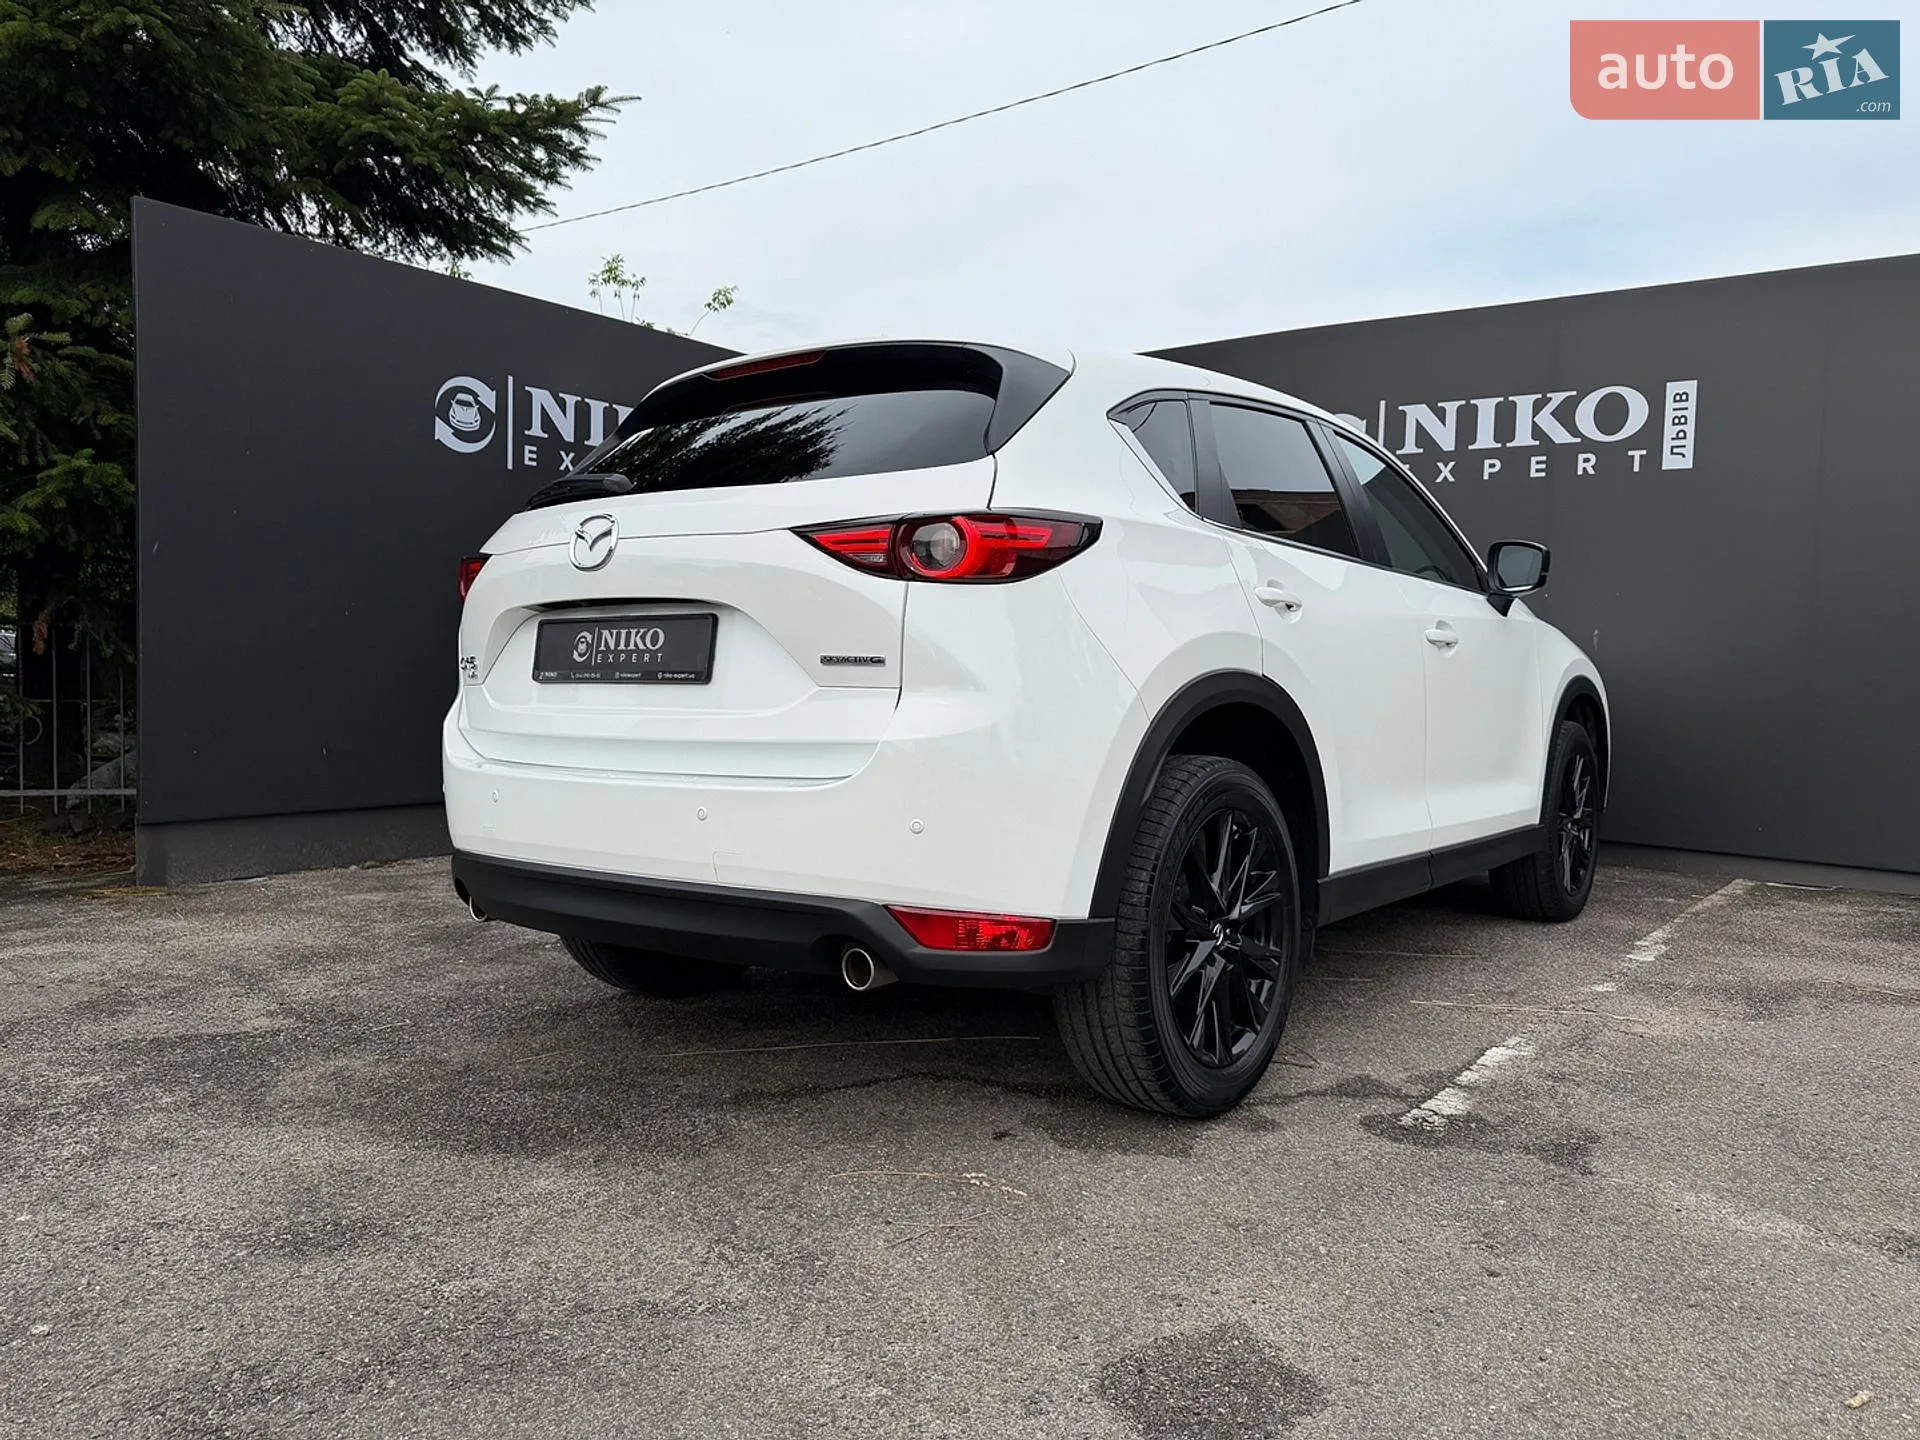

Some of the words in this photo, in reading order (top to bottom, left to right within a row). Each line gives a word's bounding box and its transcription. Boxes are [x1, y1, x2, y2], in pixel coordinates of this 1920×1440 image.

[1396, 385, 1649, 455] NIKO
[1669, 391, 1689, 458] ЛЬВІВ
[1402, 449, 1647, 483] XPERT
[599, 627, 665, 651] NIKO
[597, 653, 663, 663] EXPERT
